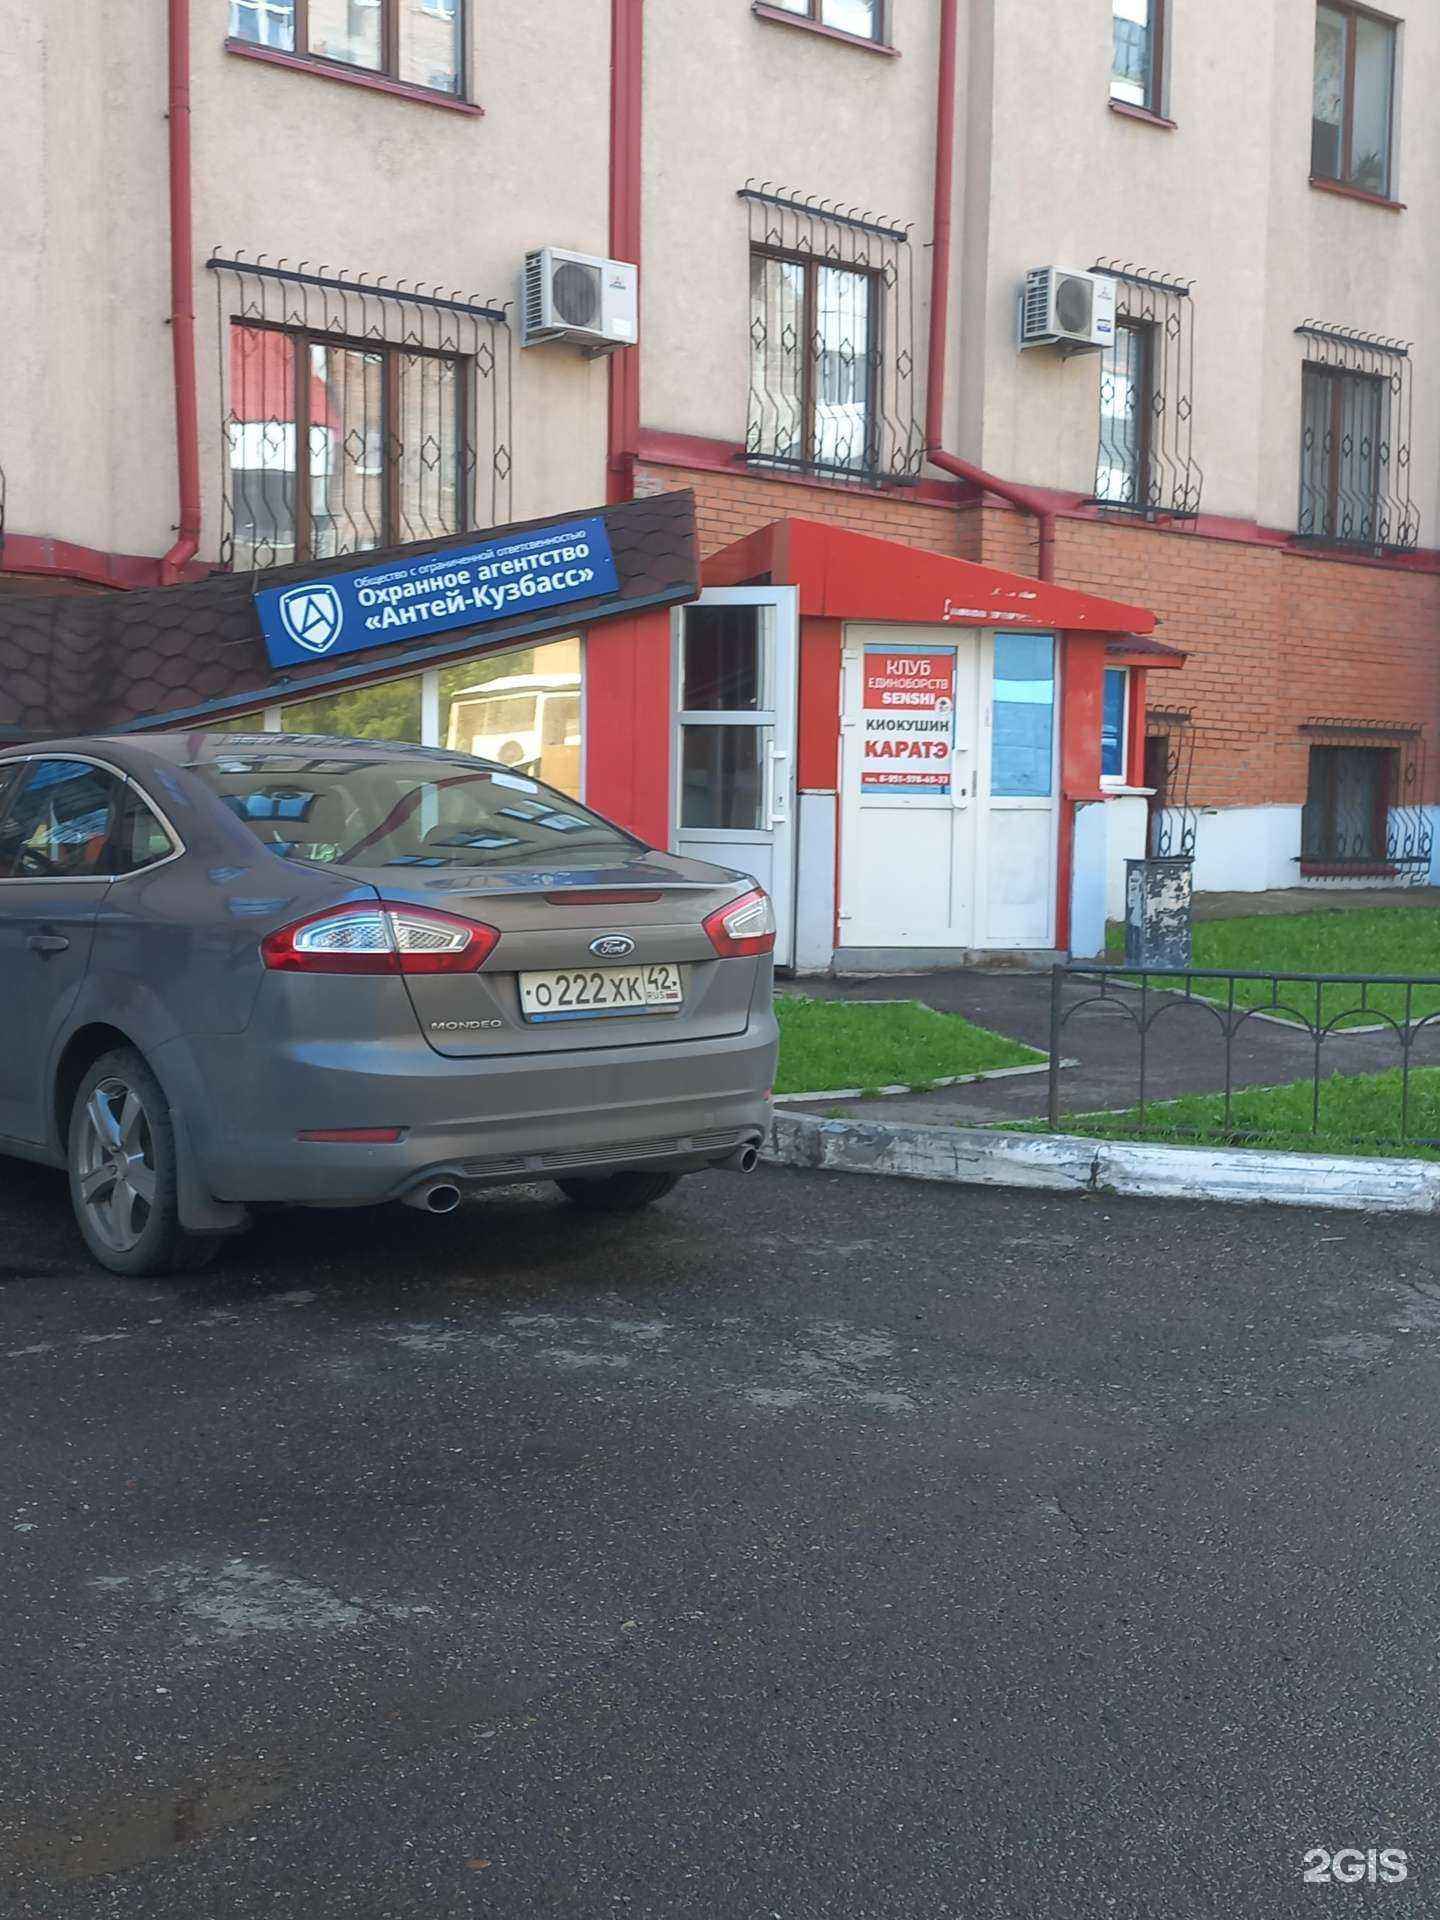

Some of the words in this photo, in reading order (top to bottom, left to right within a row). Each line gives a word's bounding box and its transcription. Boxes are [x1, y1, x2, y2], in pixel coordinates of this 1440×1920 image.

[353, 570, 408, 588] Общество
[418, 548, 495, 575] ограниченной
[358, 570, 471, 607] Охранное
[477, 543, 590, 581] агентство
[364, 567, 594, 630] «Антей-Кузбасс»
[886, 660, 931, 676] КЛУБ
[868, 677, 949, 690] ЕДИНОБОРСТВ
[881, 692, 936, 705] SENSHI
[866, 719, 950, 732] КИОКУШИН
[864, 740, 949, 759] КАРАТЭ
[600, 940, 627, 954] Ford
[430, 1018, 503, 1031] MONDEO
